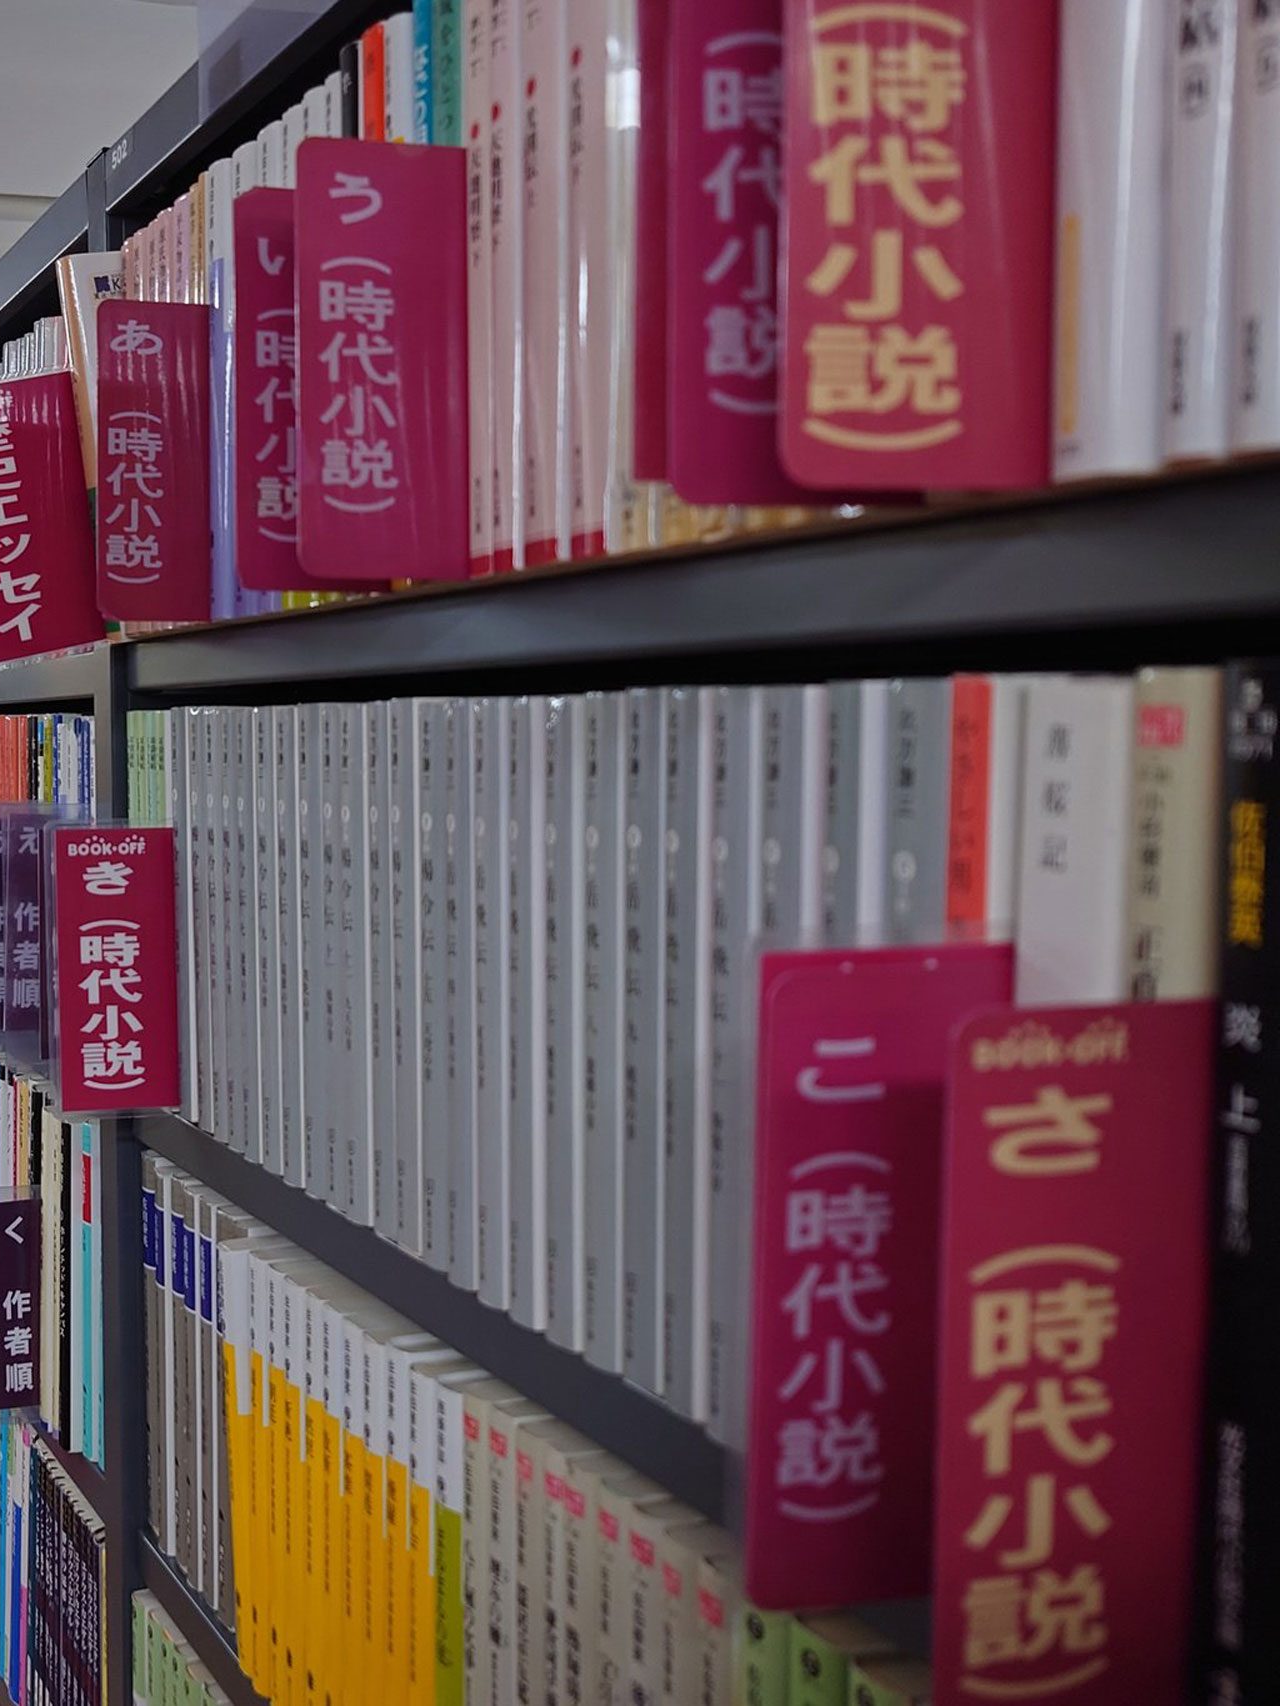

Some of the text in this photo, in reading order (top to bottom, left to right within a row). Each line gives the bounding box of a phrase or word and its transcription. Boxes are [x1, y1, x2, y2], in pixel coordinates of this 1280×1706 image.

[111, 139, 128, 169] 502
[3, 1290, 35, 1393] 作者順
